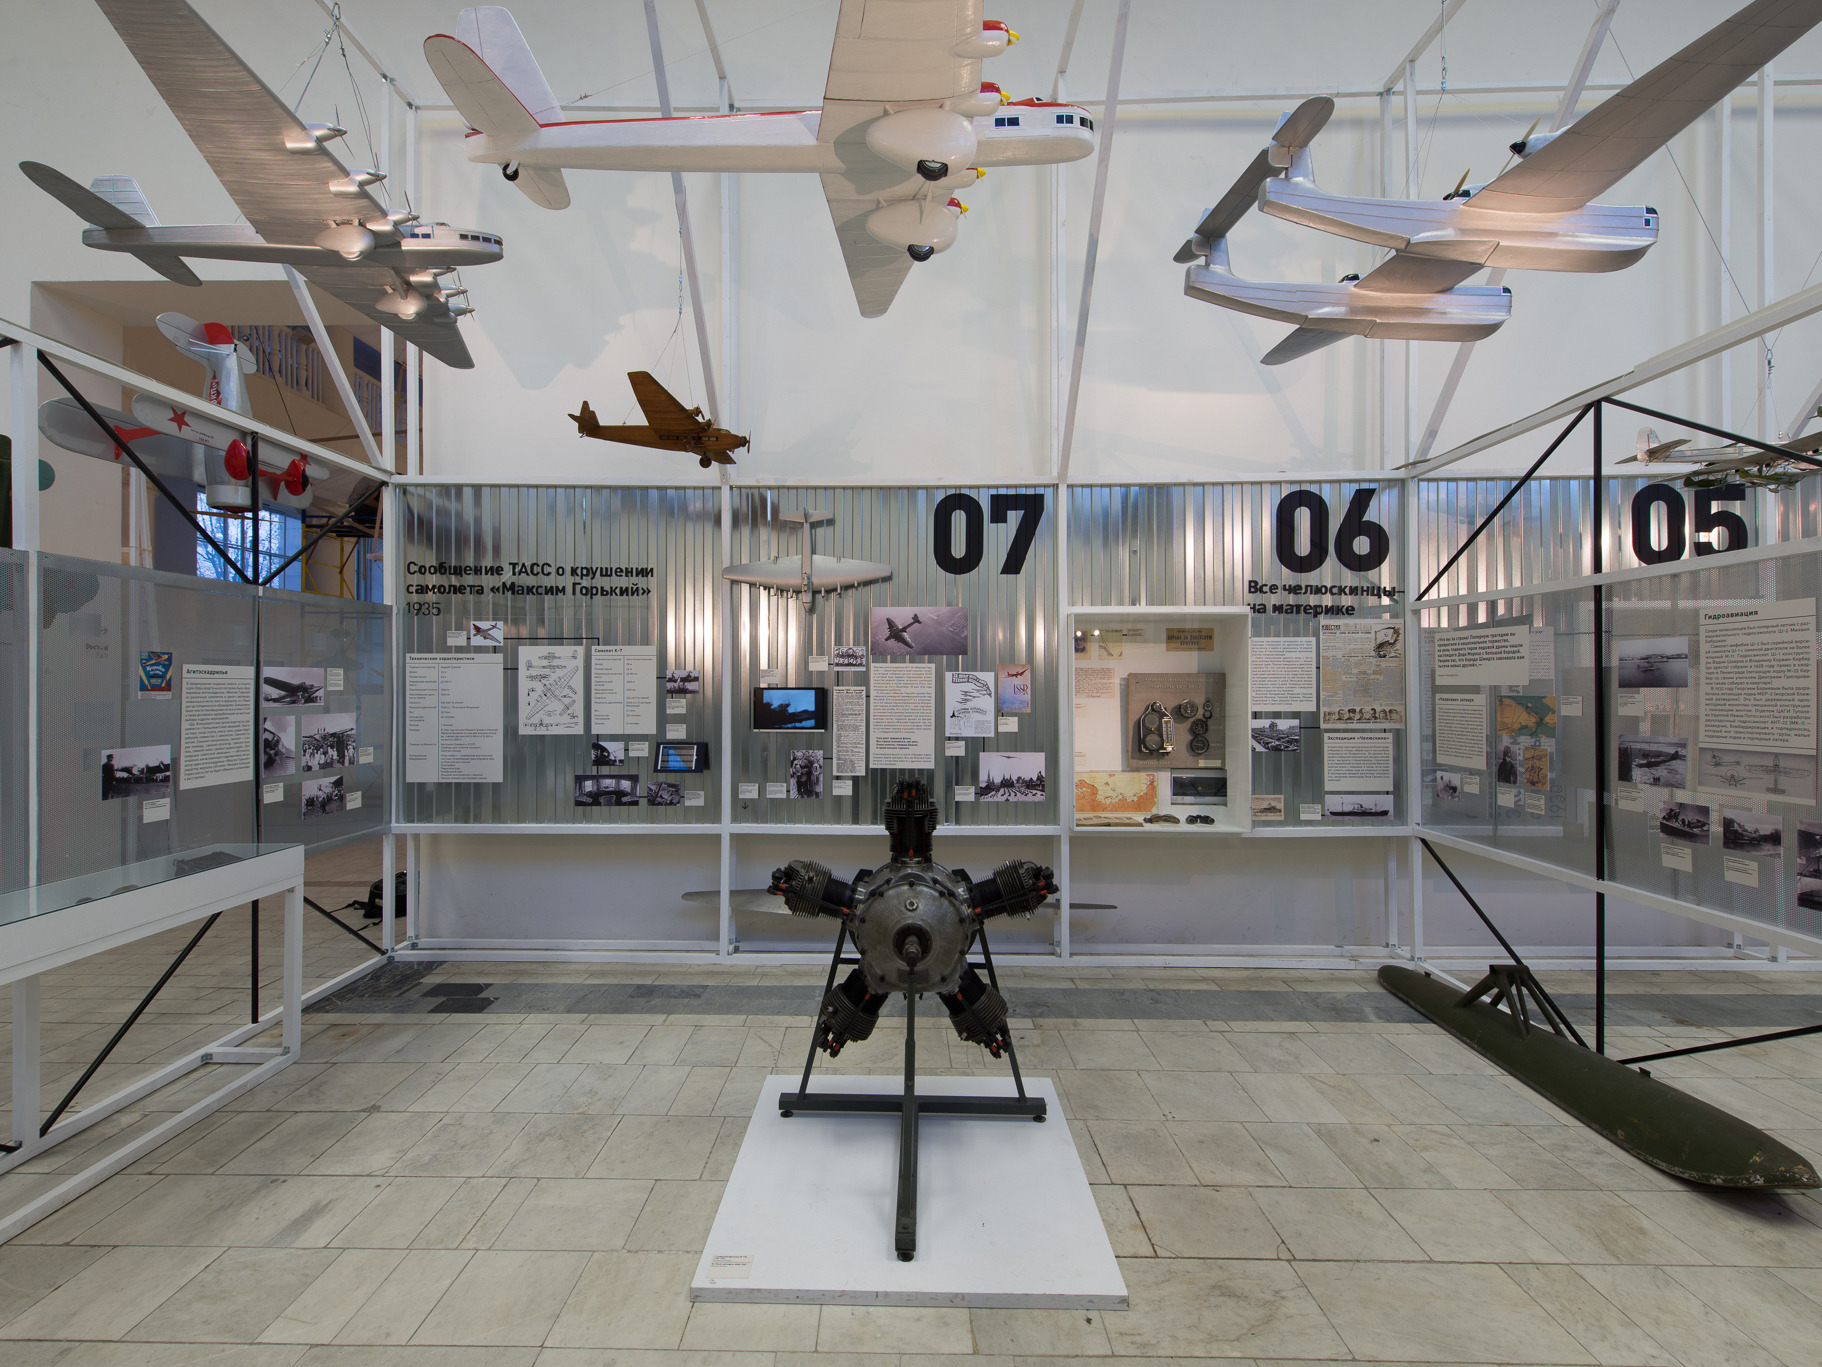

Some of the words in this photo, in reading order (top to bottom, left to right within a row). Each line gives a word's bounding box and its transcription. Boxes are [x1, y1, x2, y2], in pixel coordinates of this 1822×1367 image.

[934, 492, 1044, 575] 07
[1276, 488, 1389, 574] 06
[1631, 483, 1748, 566] 05
[406, 562, 504, 578] Сообщение
[509, 562, 552, 576] ТАСС
[556, 566, 564, 576] о
[570, 565, 654, 580] крушении
[406, 584, 484, 596] самолета
[490, 583, 566, 596] «Максим
[572, 583, 652, 600] Горький»
[1248, 580, 1278, 594] Все
[1282, 584, 1396, 599] челюскинцы
[406, 602, 442, 616] 1935
[1272, 603, 1356, 618] материке
[1704, 610, 1758, 620] Гидроавиация
